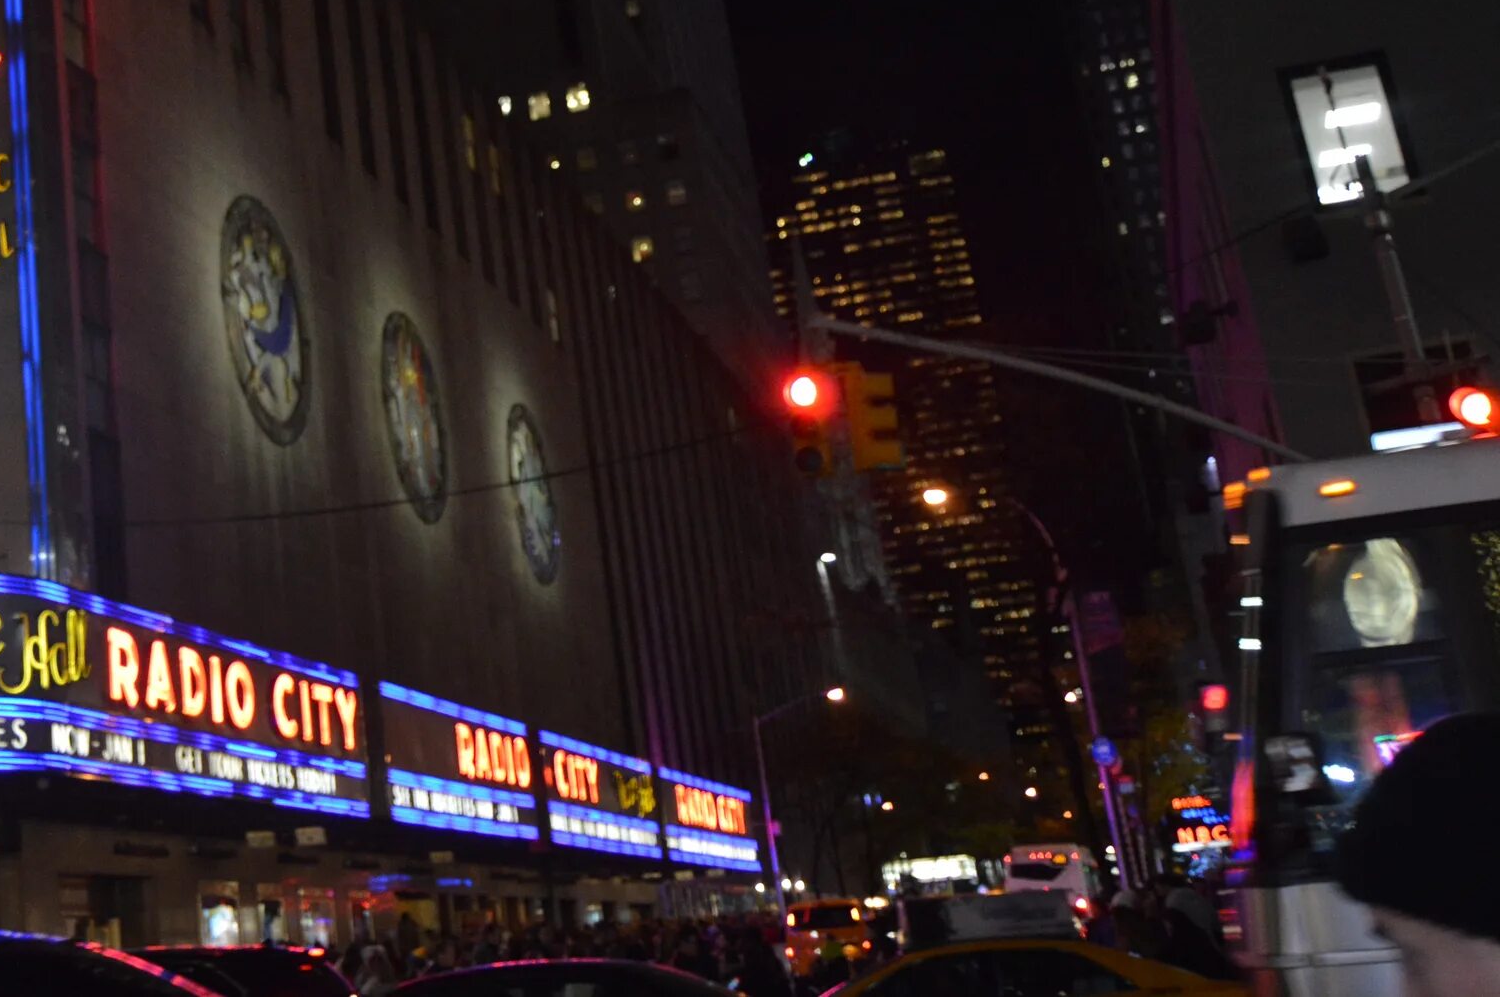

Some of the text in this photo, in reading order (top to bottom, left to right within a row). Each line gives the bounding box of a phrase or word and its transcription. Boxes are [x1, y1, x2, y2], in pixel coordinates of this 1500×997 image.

[107, 627, 357, 750] RADIO CITY
[453, 720, 532, 789] RADIO
[553, 749, 600, 804] CITY
